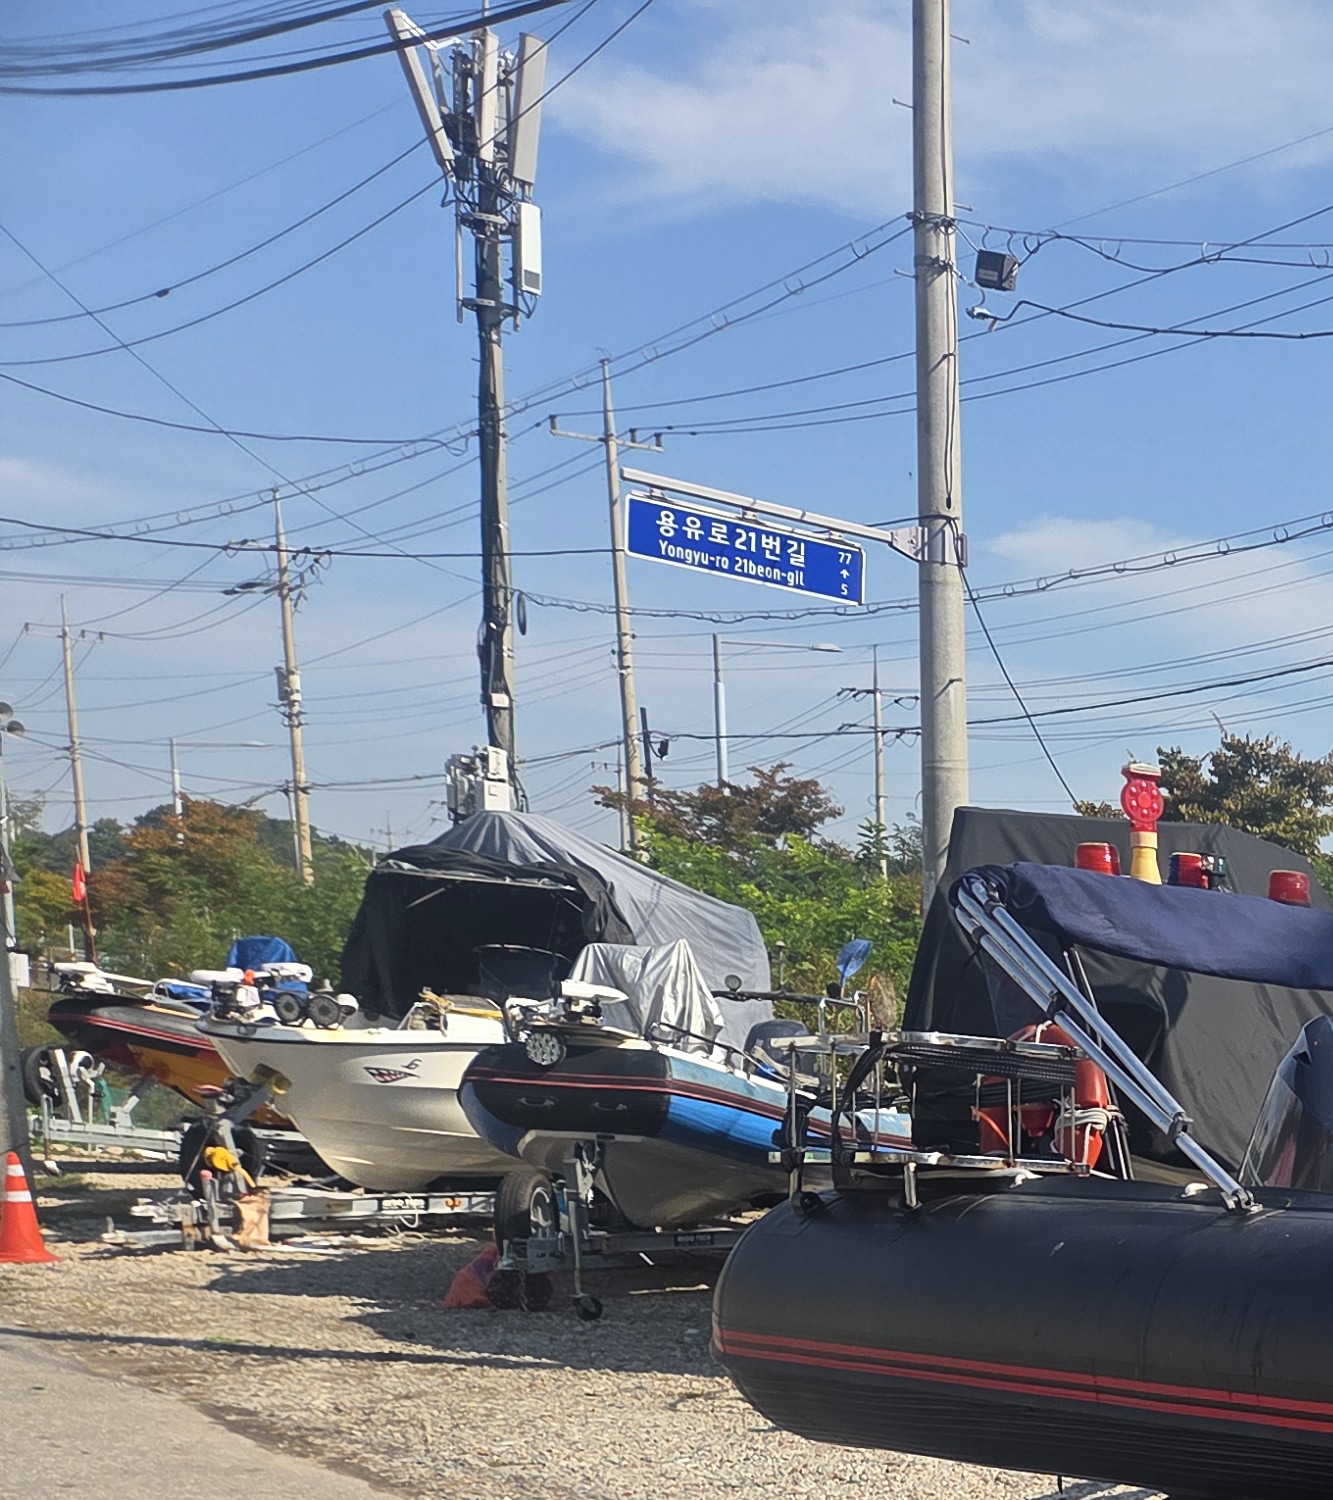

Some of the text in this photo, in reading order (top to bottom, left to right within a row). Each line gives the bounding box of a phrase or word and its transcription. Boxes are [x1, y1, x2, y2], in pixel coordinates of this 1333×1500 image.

[656, 510, 805, 567] 용유로21번길
[659, 539, 805, 587] Yongyu-ro 21beon-gil
[838, 552, 853, 566] 77
[841, 583, 849, 596] 5
